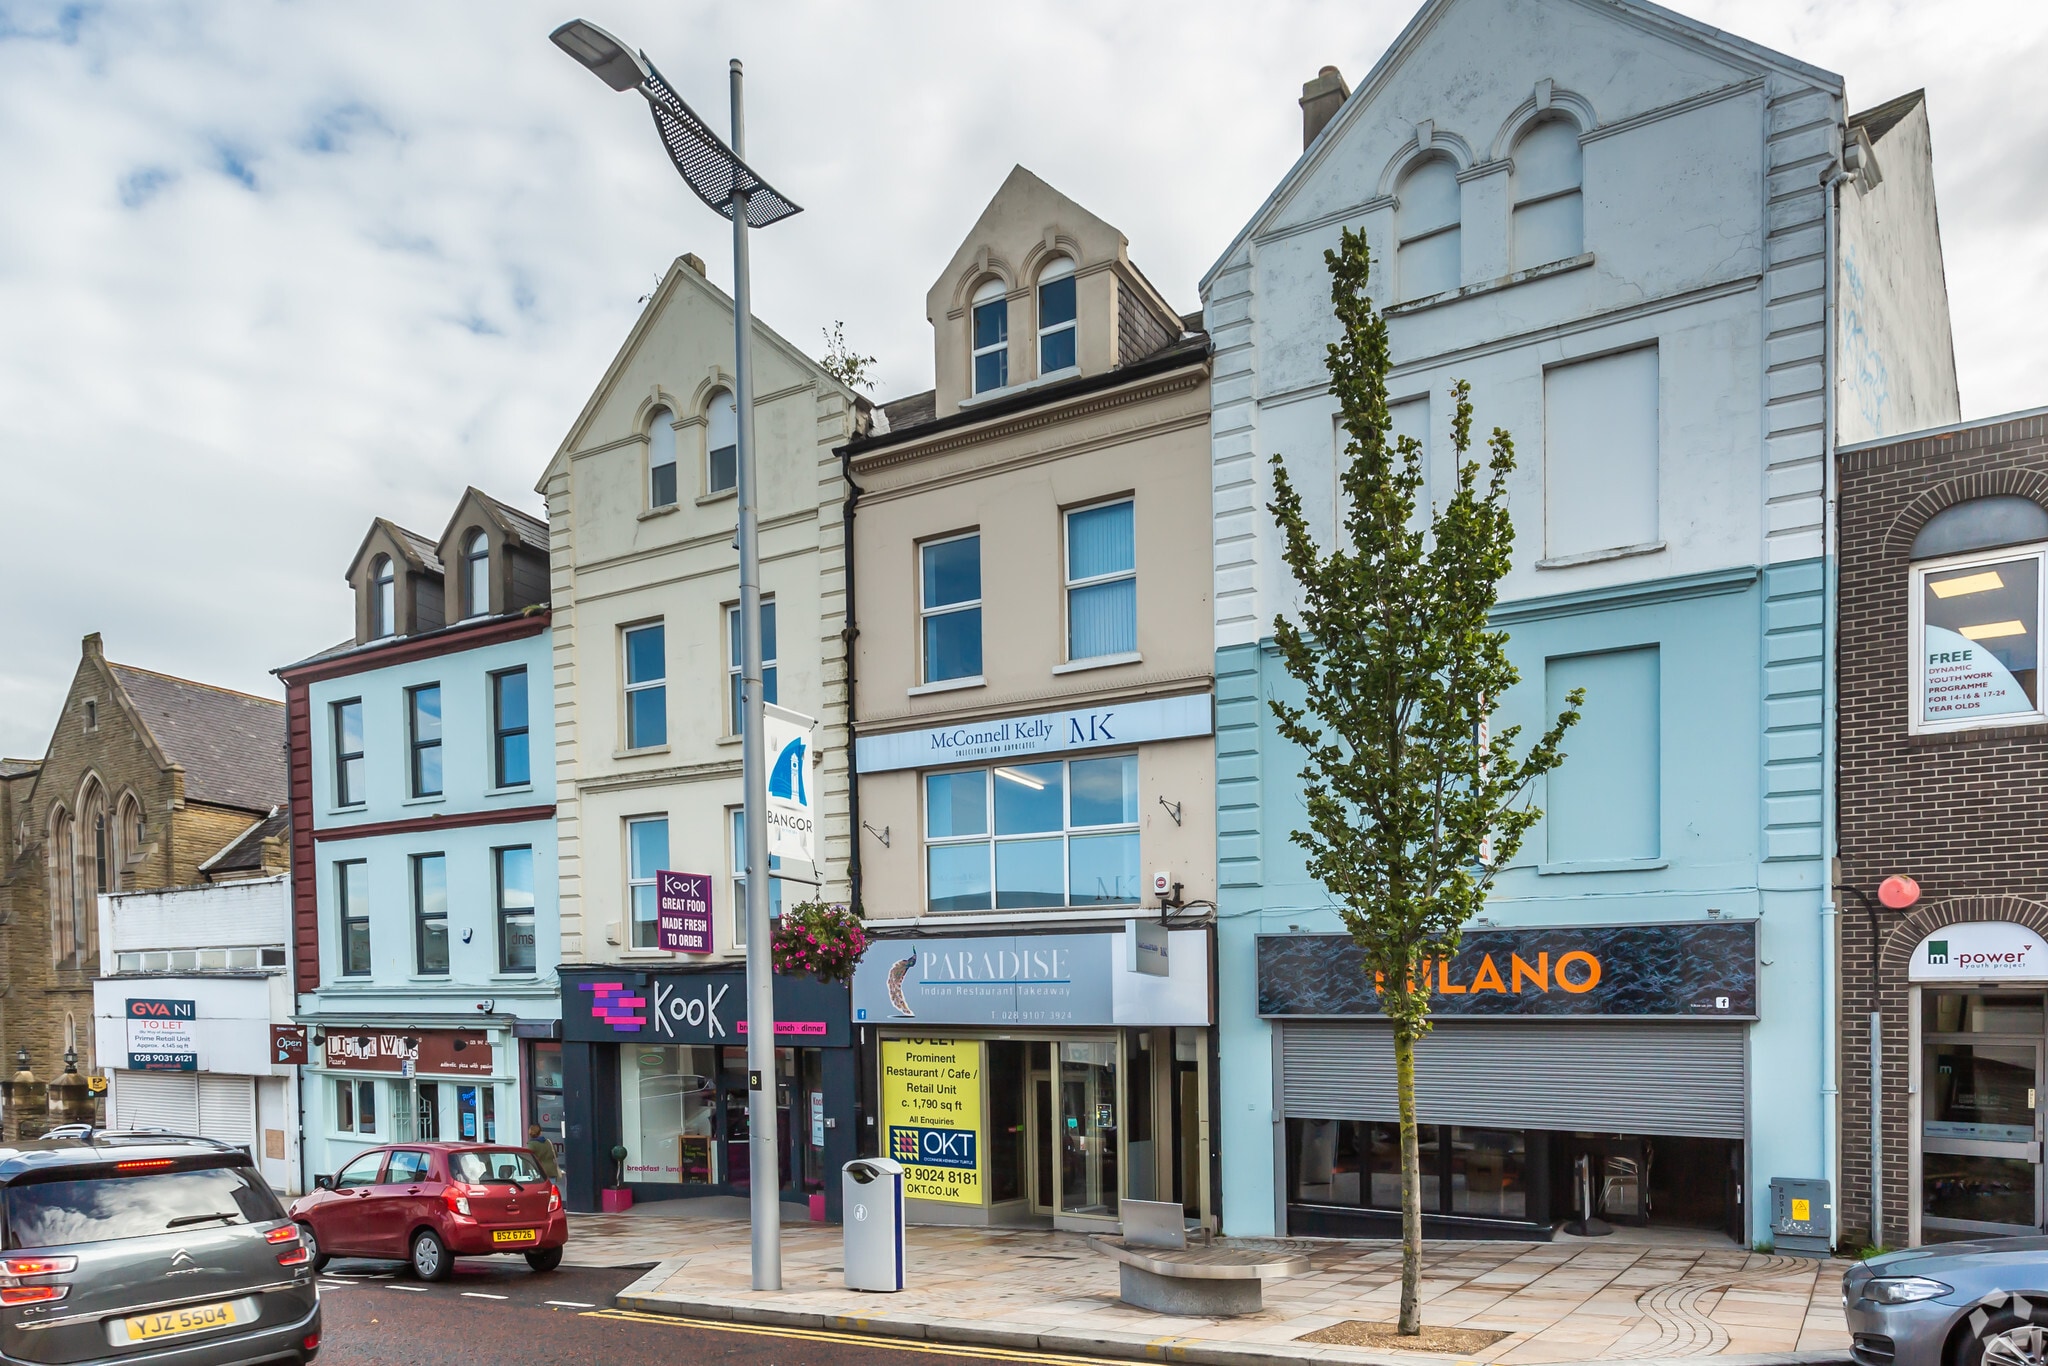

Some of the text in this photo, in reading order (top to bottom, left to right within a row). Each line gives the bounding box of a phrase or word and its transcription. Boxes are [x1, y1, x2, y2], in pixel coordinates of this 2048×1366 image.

[1929, 650, 1972, 664] FREE
[1929, 664, 1972, 674] DYNAMIC
[1929, 672, 1993, 684] YOUTH WORK
[1928, 682, 1988, 693] PROGRAMME
[1950, 693, 1971, 701] 14-16
[1955, 702, 1980, 710] OLDS
[930, 719, 1053, 750] McConnell Kelly
[1069, 713, 1115, 744] MK
[955, 747, 987, 757] SOLICITORS
[1004, 741, 1035, 751] ADVOCATES
[767, 810, 813, 833] BANGOR
[662, 897, 706, 913] GREAT FOOD
[662, 917, 707, 932] MADE FRESH
[511, 931, 534, 945] dms
[667, 933, 703, 948] TO ORDER
[923, 949, 1071, 980] PARADISE
[921, 986, 1070, 997] Indian Restaurant Takeaway
[131, 1002, 191, 1016] GVA NI
[1002, 1011, 1019, 1020] 028
[1022, 1011, 1045, 1020] 9107
[1050, 1011, 1072, 1020] 3924
[141, 1020, 183, 1030] TO LET
[776, 1023, 824, 1033] lunch dinner
[276, 1037, 302, 1050] Open
[134, 1054, 151, 1062] 028
[152, 1054, 173, 1062] 9031
[906, 1052, 956, 1063] Prominent
[886, 1066, 978, 1079] Restaurant / Cafe /
[751, 1075, 758, 1085] 8
[906, 1083, 957, 1095] Retail Unit
[901, 1099, 962, 1112] c. 1,790 sq ft
[909, 1115, 954, 1126] All Enquiries
[923, 1131, 973, 1157] OKT
[626, 1164, 660, 1172] breakfast
[915, 1168, 944, 1182] 9024
[948, 1171, 977, 1185] 8181
[907, 1183, 959, 1197] OKT.CO.UK
[496, 1230, 532, 1240] BSZ 6726
[135, 1308, 228, 1336] YJZ 5504
